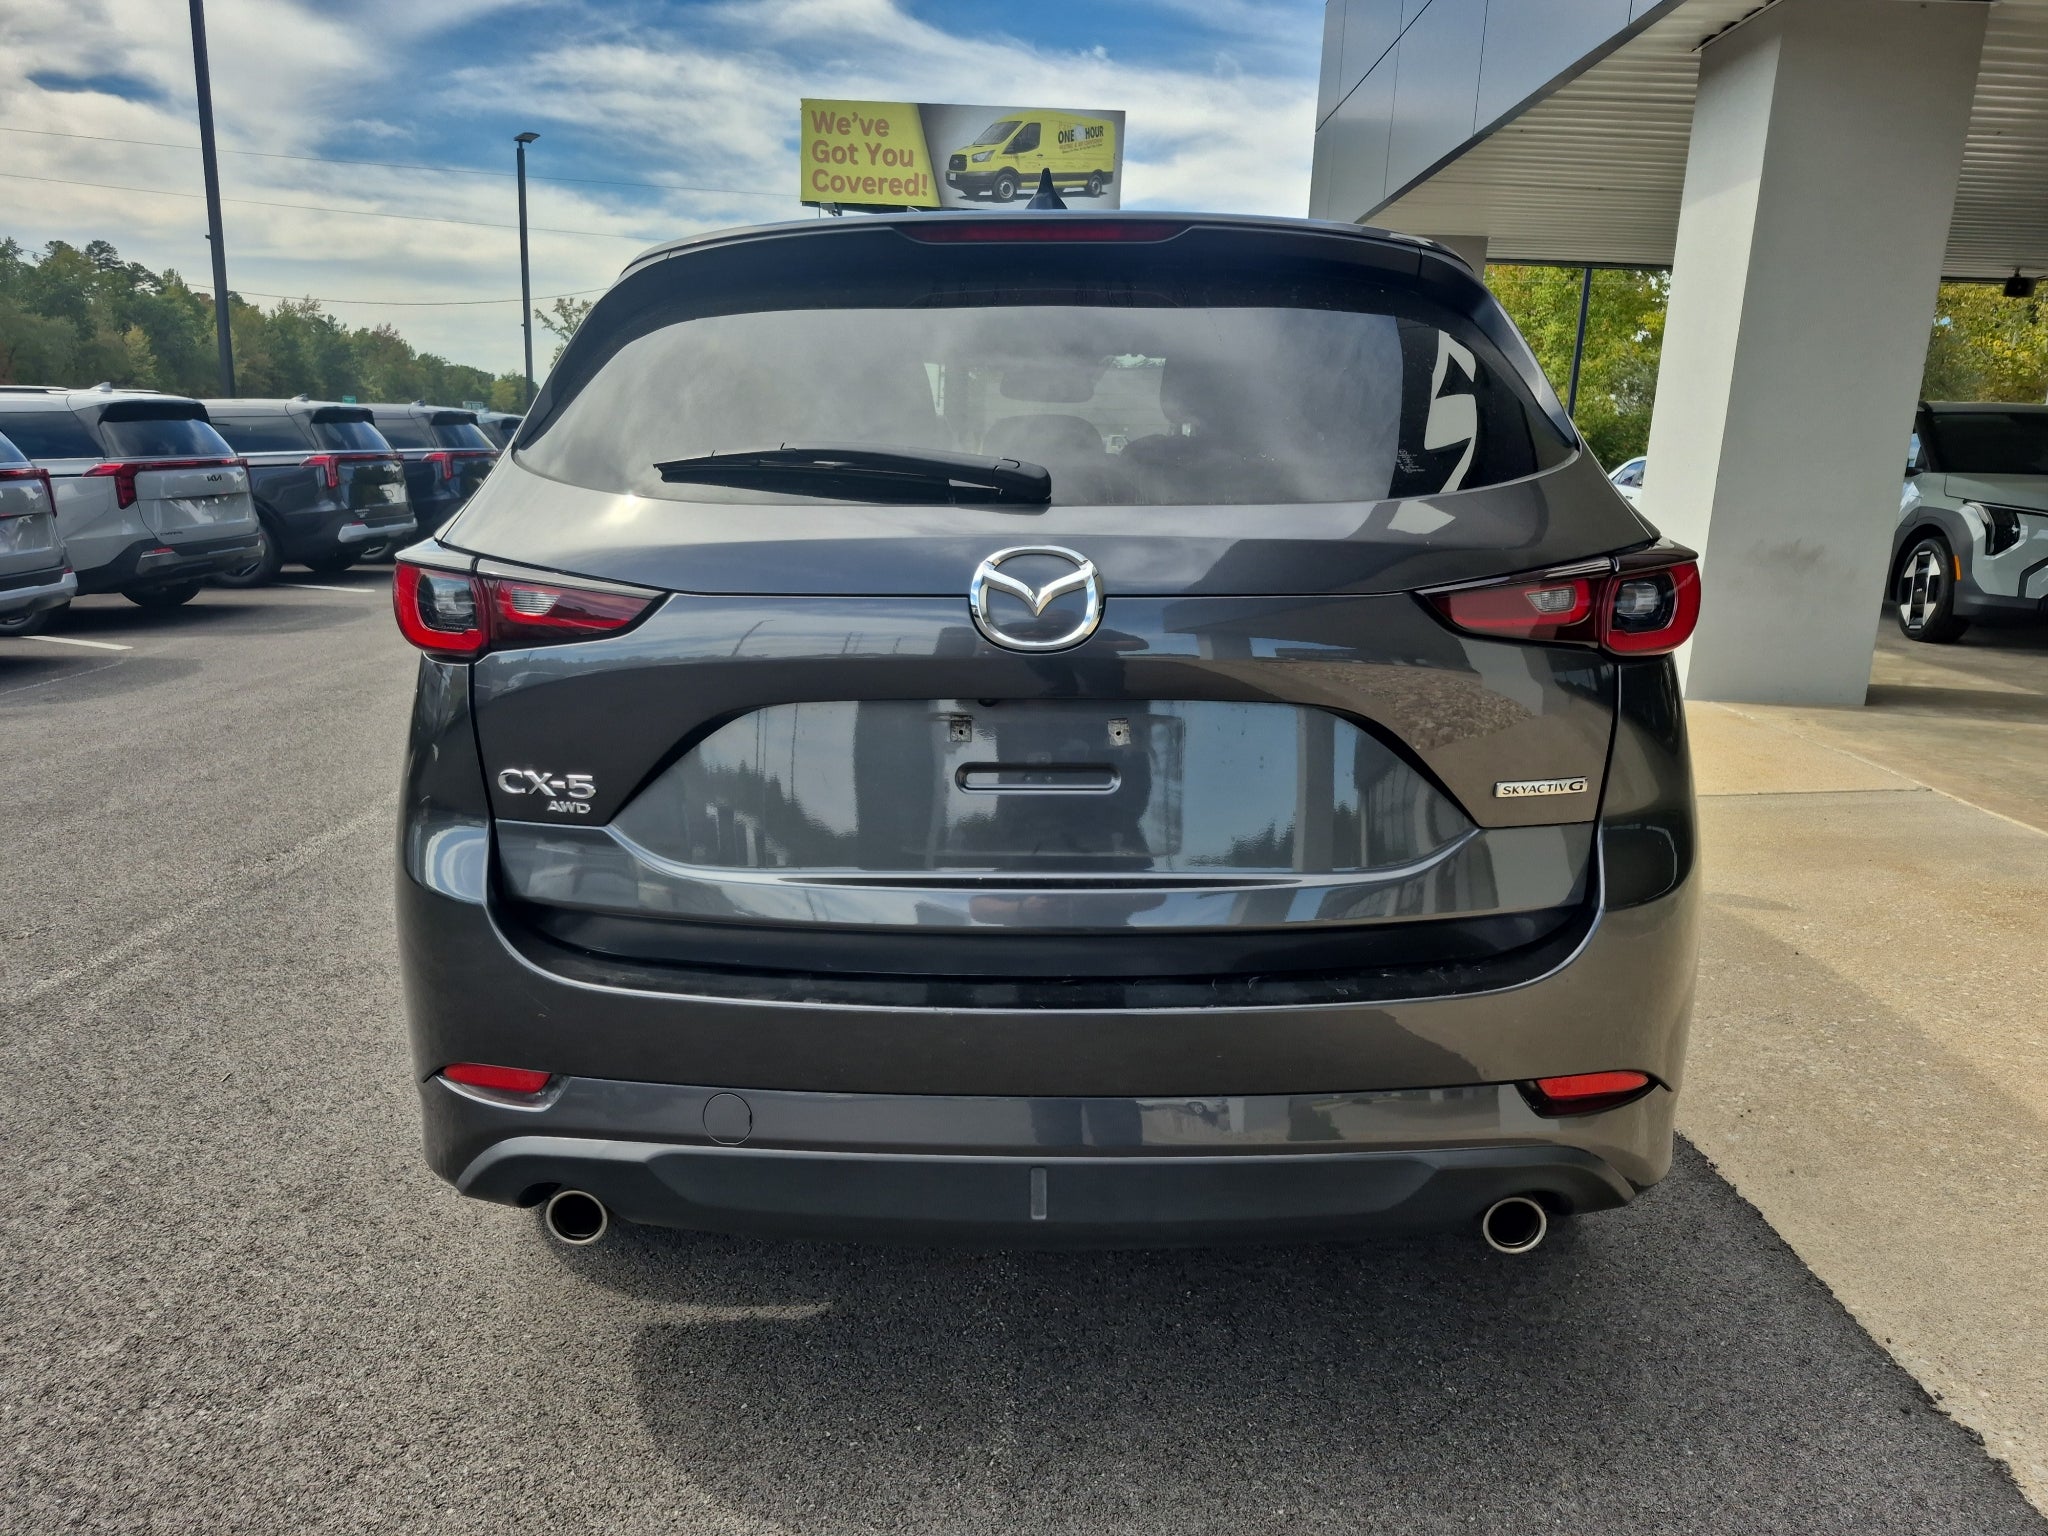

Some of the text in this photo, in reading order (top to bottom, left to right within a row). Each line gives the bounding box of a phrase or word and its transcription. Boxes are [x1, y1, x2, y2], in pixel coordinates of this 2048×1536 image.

[811, 110, 890, 137] We've
[1058, 129, 1075, 144] ONE
[1085, 126, 1104, 139] HOUR
[812, 140, 914, 167] Got You
[812, 169, 928, 197] Covered!
[498, 768, 596, 799] CX-5
[1502, 783, 1567, 795] SKYACTIV
[547, 800, 591, 814] AWD
